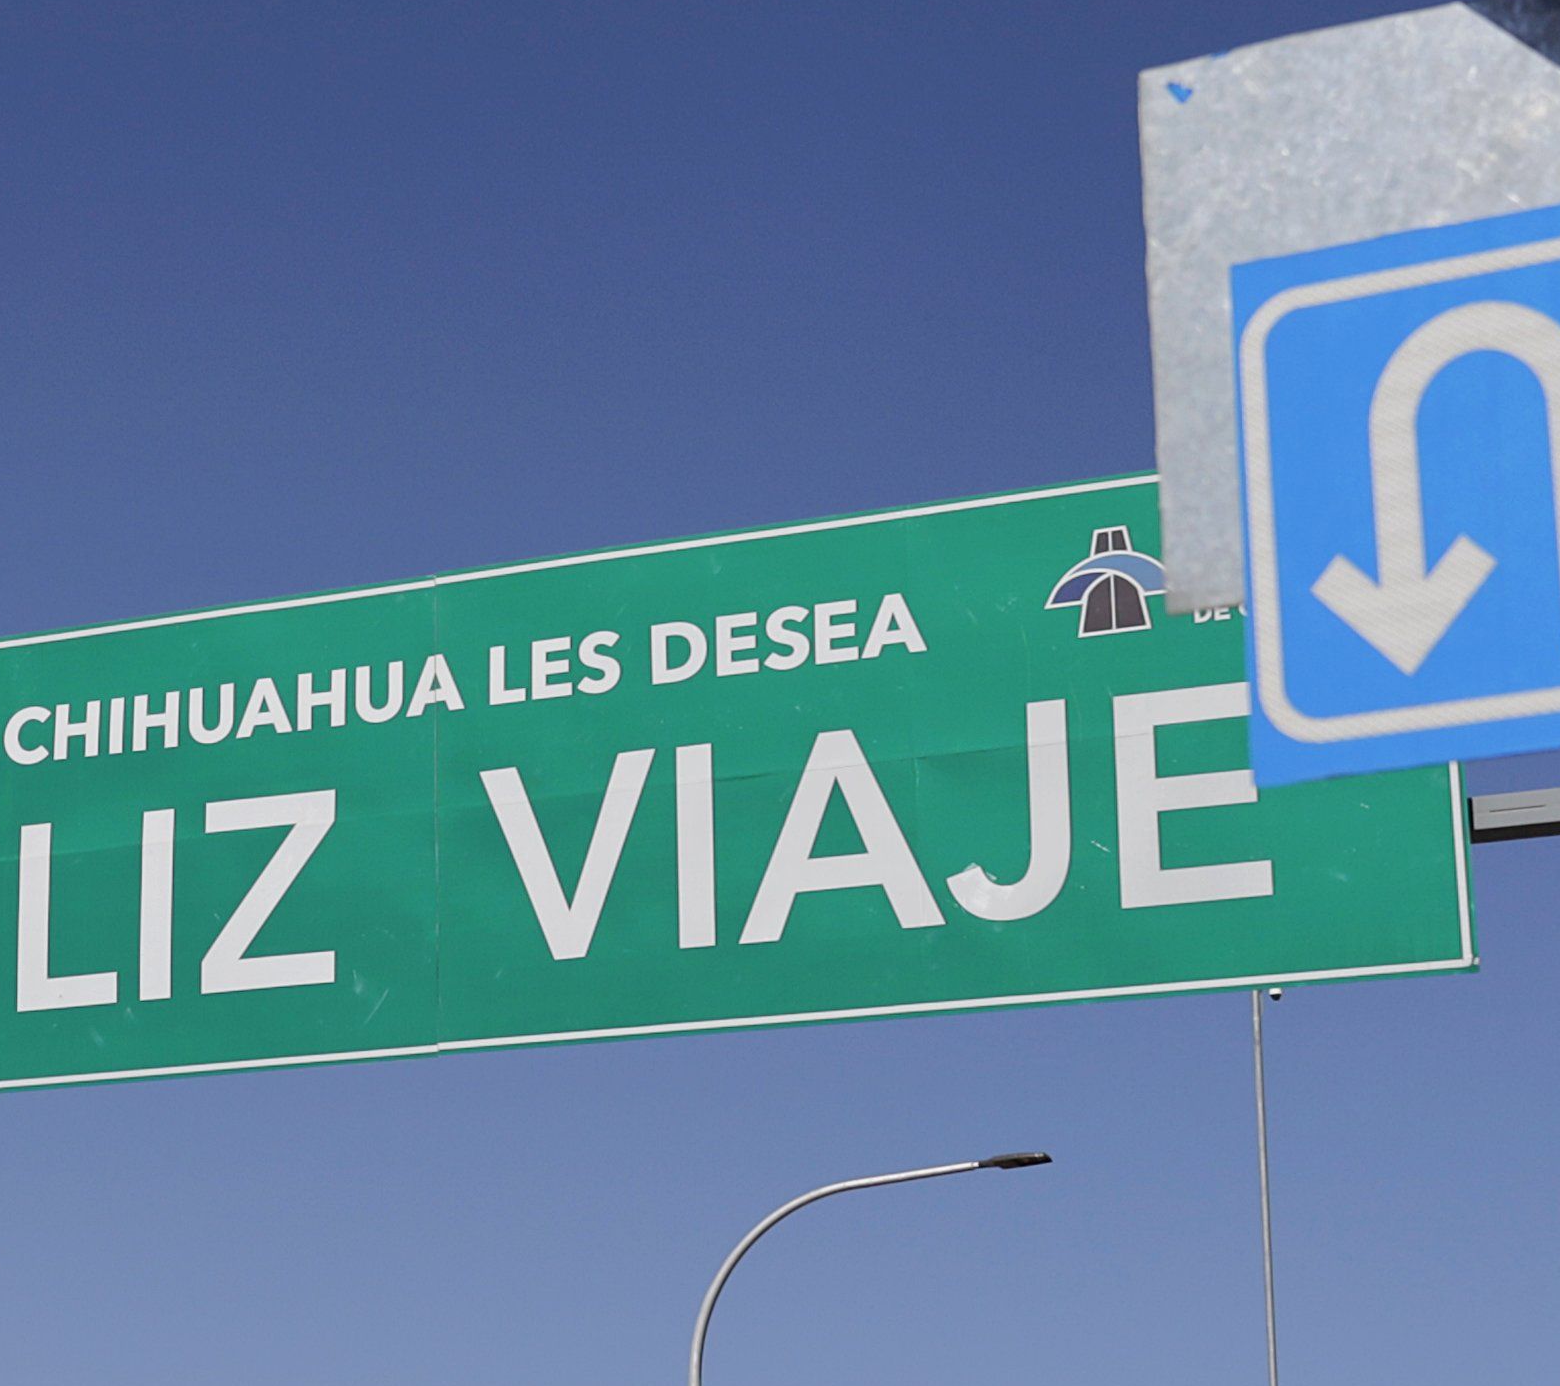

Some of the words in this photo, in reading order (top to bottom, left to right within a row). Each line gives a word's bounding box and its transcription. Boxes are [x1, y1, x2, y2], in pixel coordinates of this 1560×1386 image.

[2, 653, 466, 765] CHIHUAHUA
[488, 630, 622, 707] LES
[649, 592, 928, 686] DESEA
[478, 680, 1275, 962] VIAJE
